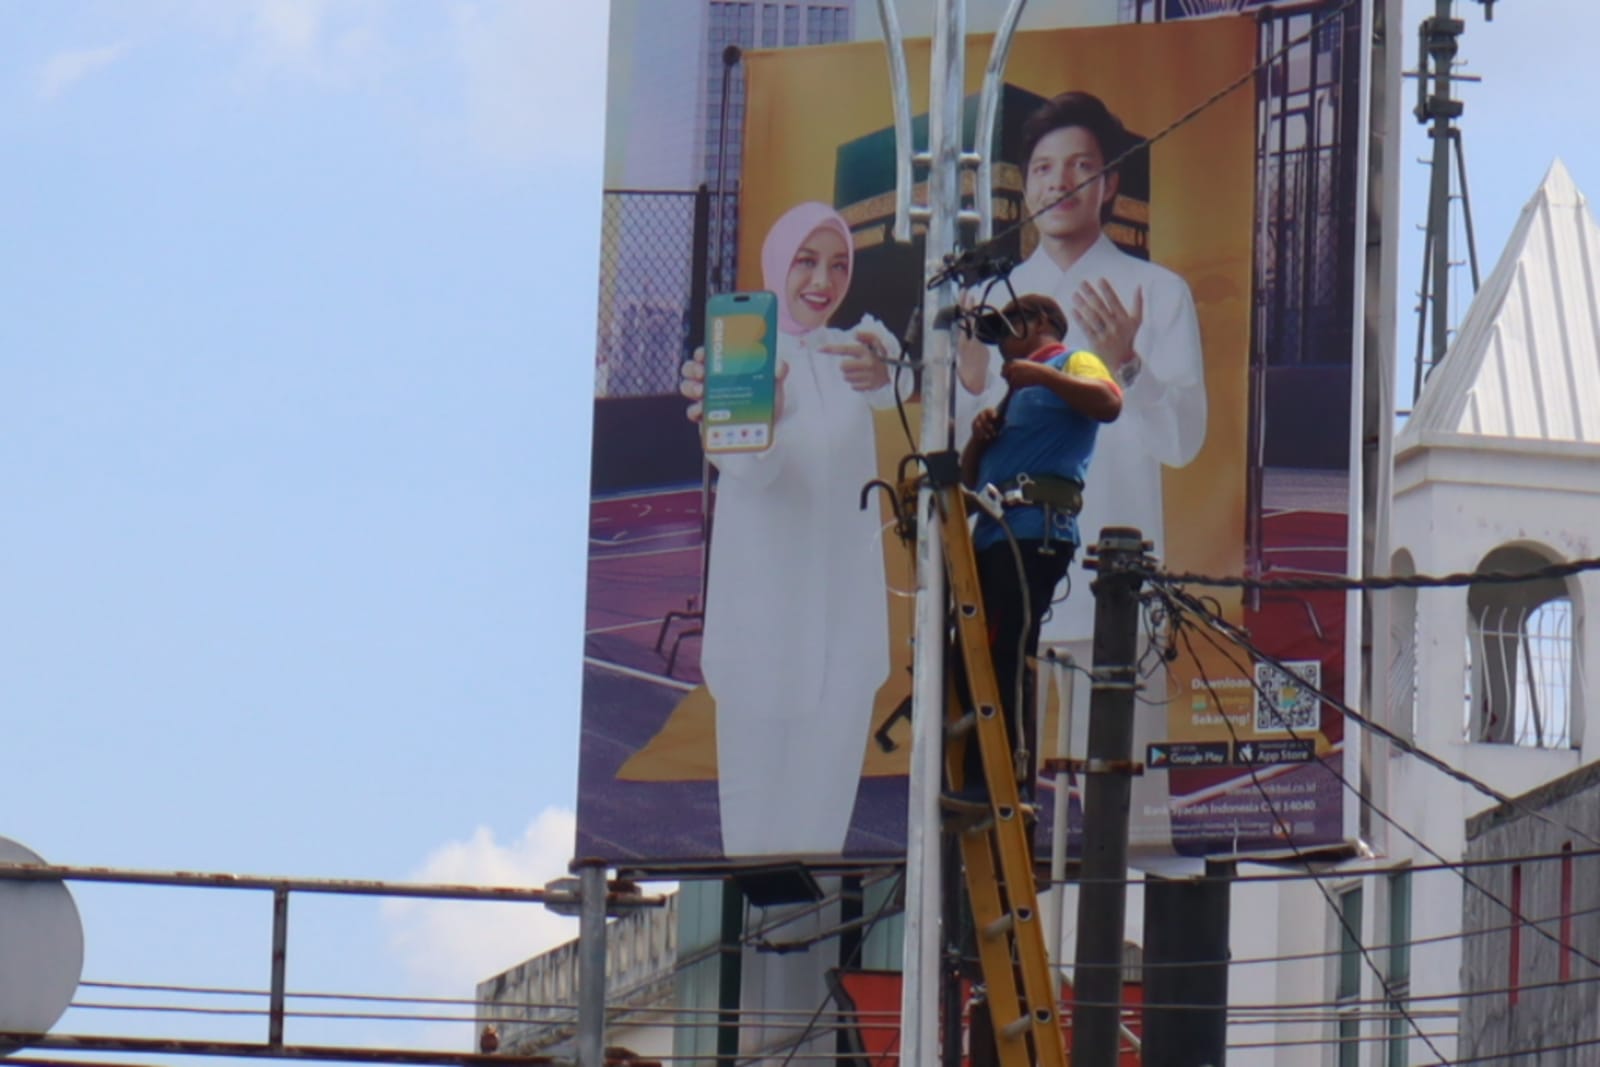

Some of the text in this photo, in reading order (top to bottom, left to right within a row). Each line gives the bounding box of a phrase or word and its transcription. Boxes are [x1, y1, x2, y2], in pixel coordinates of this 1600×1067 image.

[1170, 751, 1225, 765] Google Play
[1257, 749, 1308, 762] App Store
[1210, 802, 1259, 814] Indonesia
